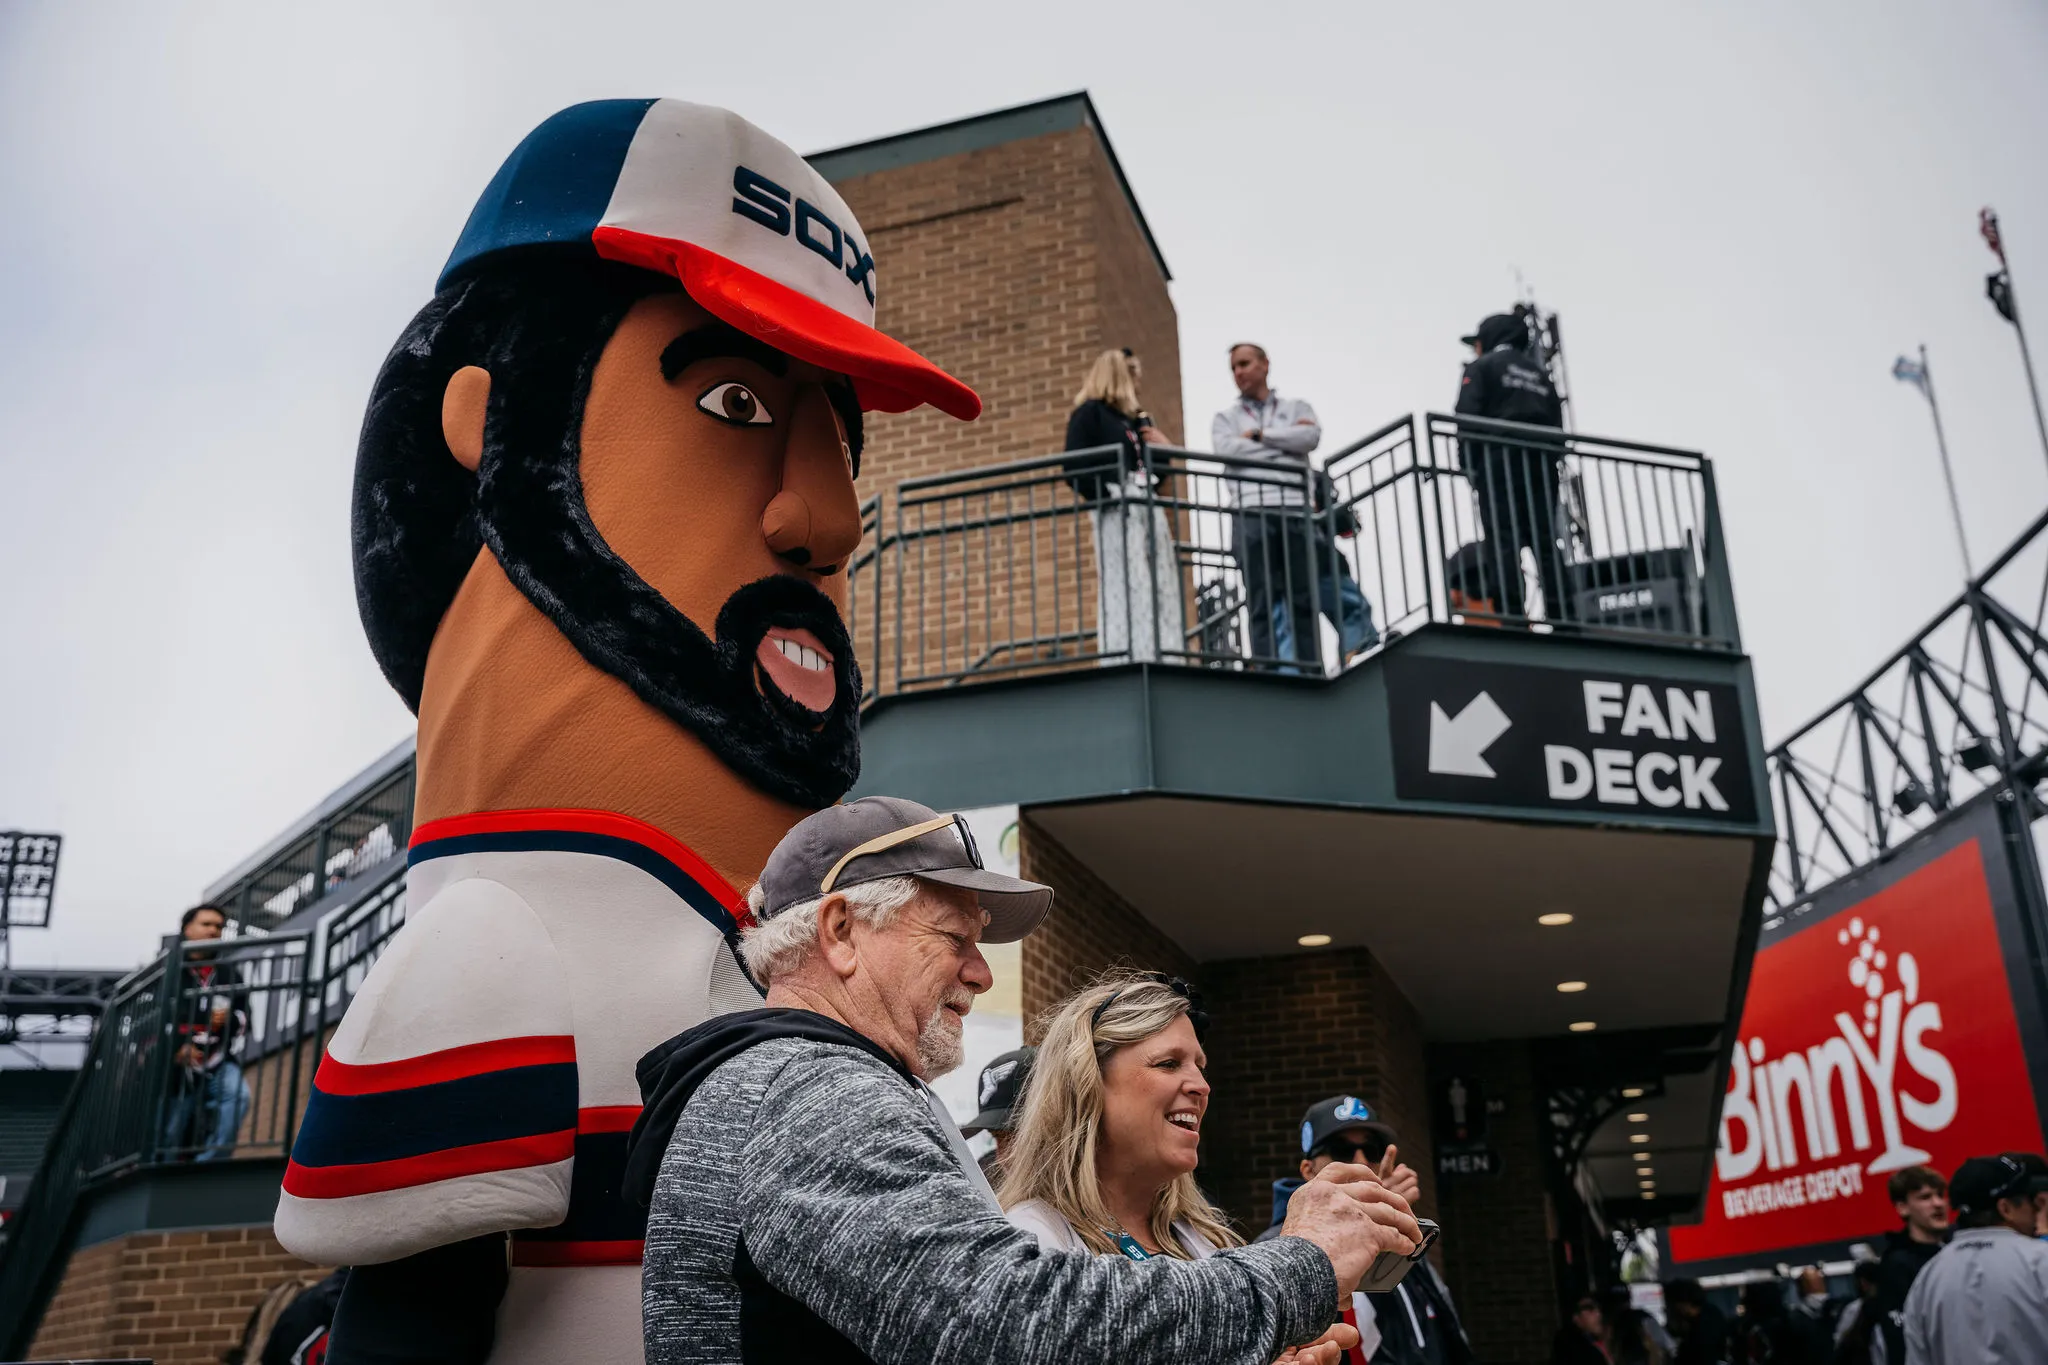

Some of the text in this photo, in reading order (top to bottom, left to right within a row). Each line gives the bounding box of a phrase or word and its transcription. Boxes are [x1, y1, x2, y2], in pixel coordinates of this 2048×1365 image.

[732, 165, 876, 309] SOX
[1582, 679, 1717, 744] FAN
[1543, 743, 1730, 812] DECK
[1440, 1154, 1490, 1174] MEN
[1722, 1162, 1863, 1219] BEVERAGE DEPOT
